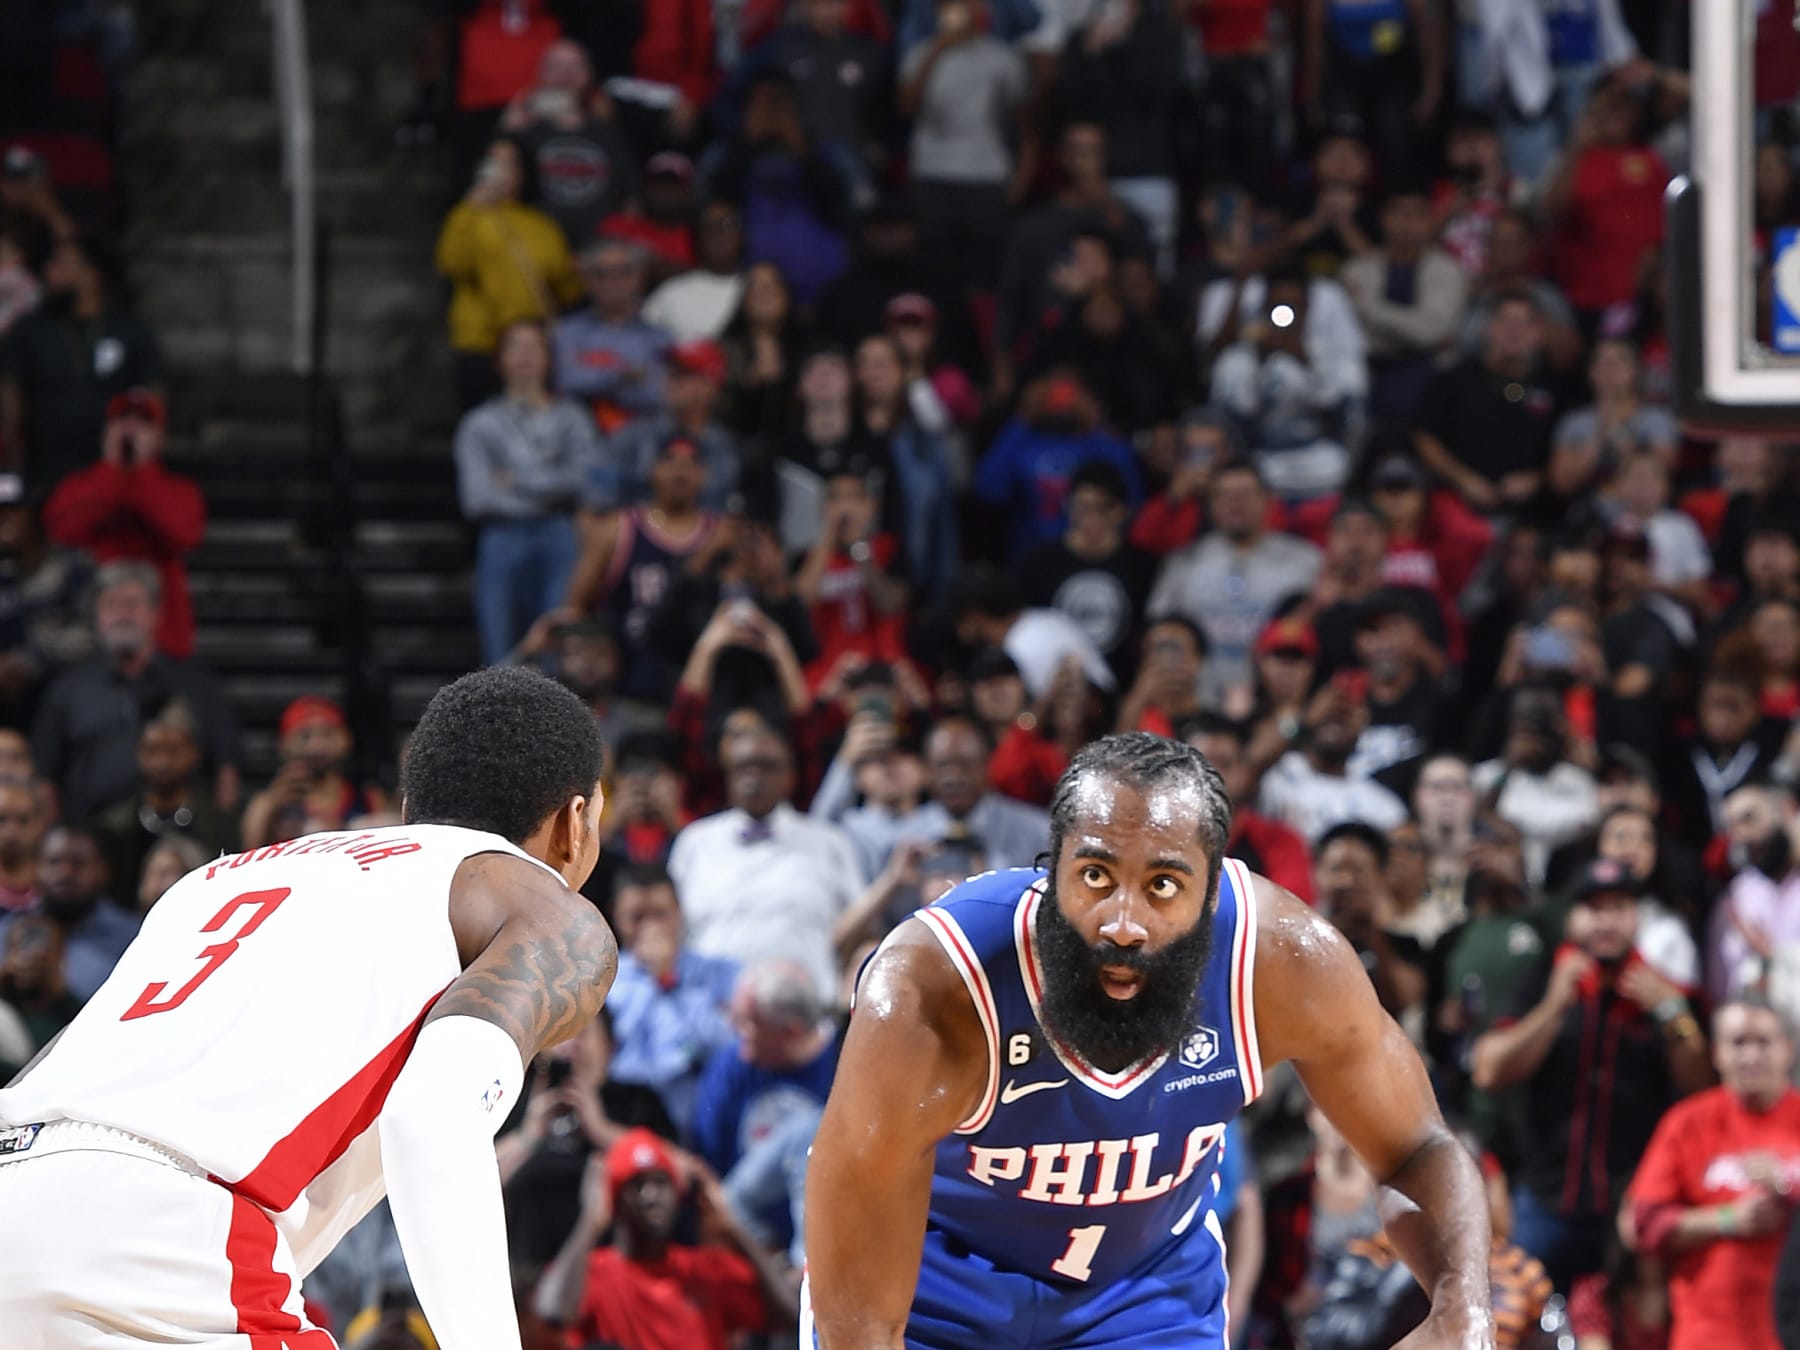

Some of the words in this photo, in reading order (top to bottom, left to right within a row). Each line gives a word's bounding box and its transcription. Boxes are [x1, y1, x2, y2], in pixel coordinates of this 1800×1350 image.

[118, 886, 292, 1022] 3
[1007, 1032, 1032, 1067] 6
[1163, 1067, 1237, 1094] crypto.com
[1050, 1224, 1107, 1283] 1
